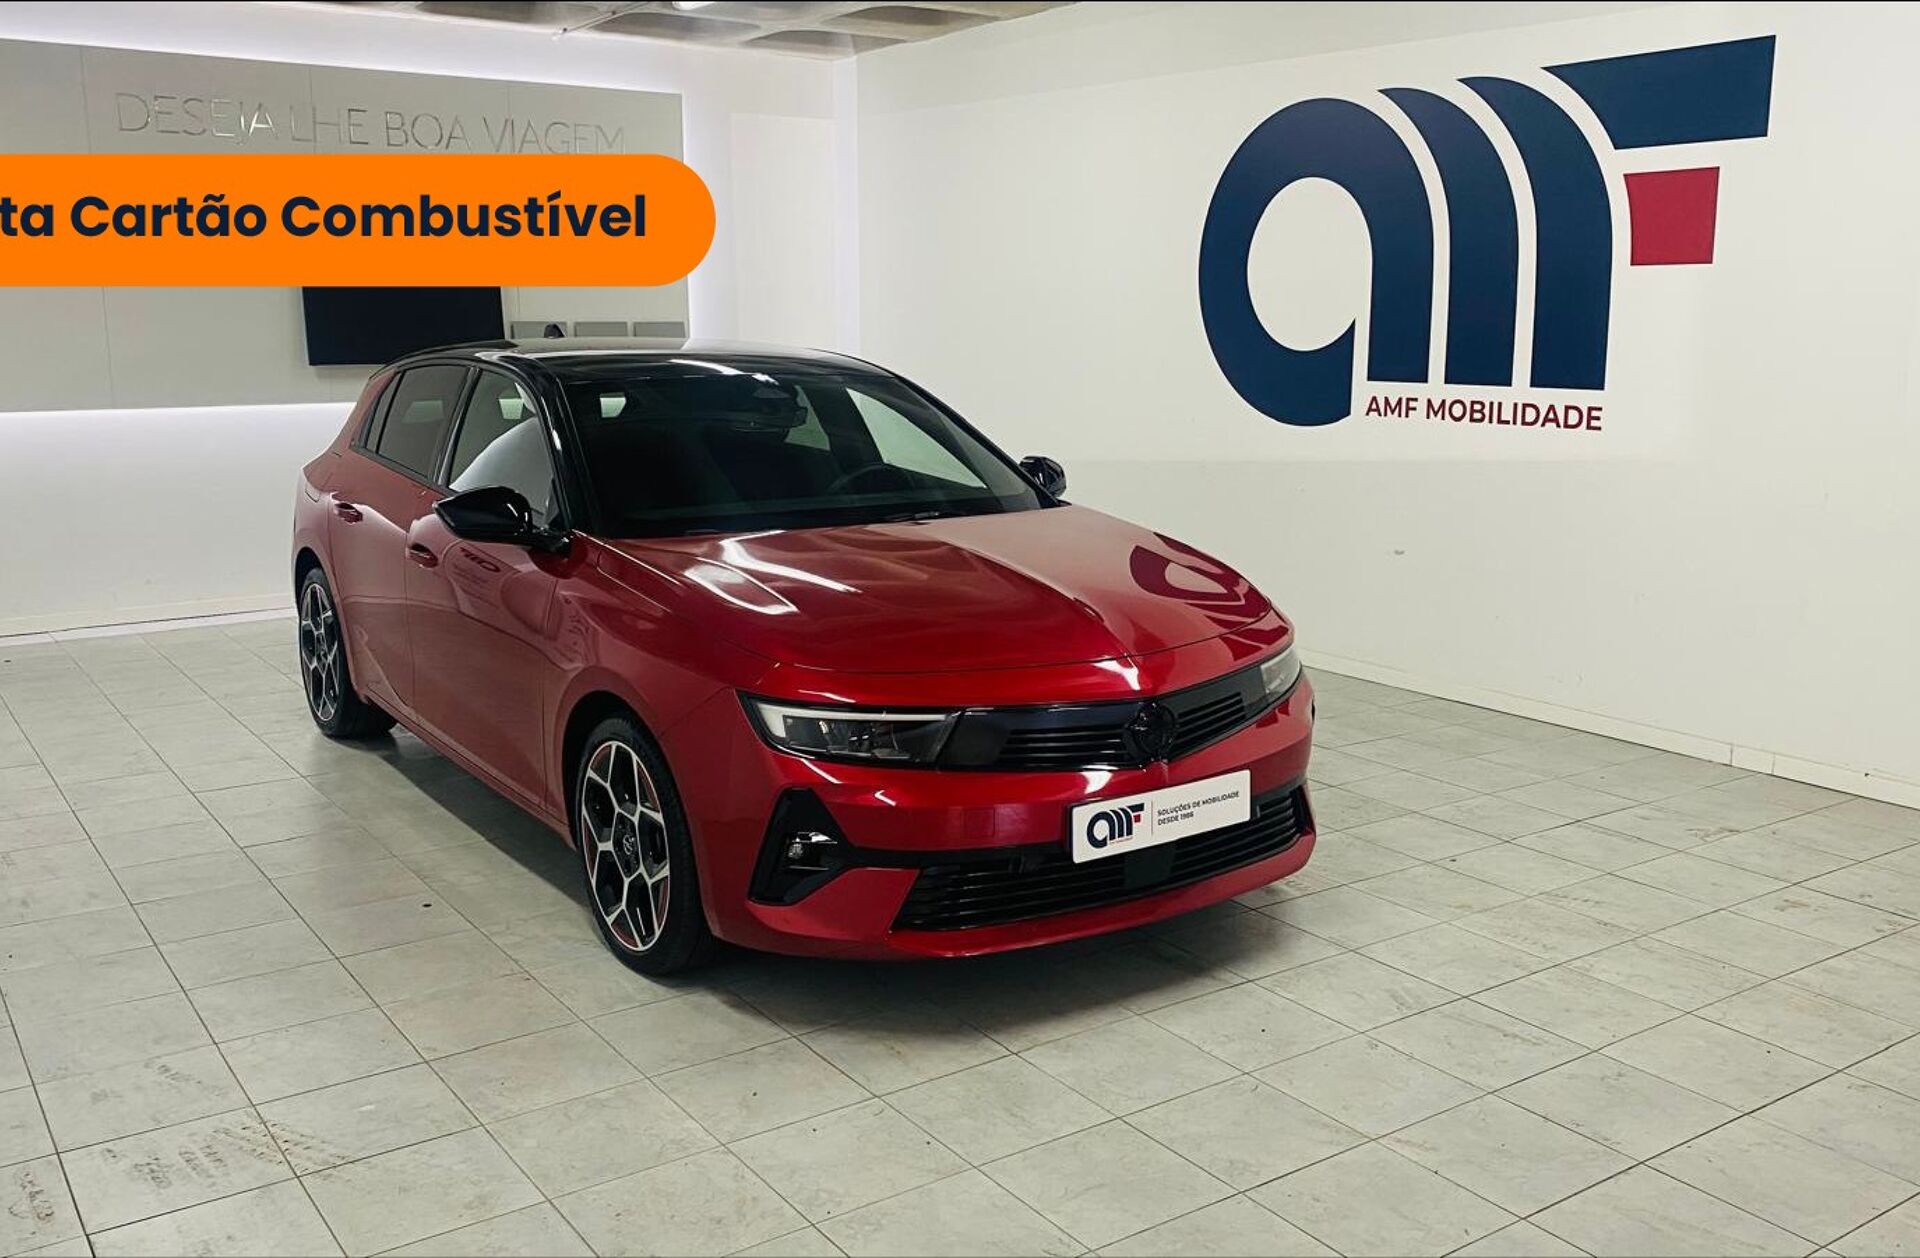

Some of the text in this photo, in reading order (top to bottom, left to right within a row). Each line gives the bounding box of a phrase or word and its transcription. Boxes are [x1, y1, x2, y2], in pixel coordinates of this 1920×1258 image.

[116, 92, 626, 155] DESEJA LHE BOA VIAGEM
[1365, 395, 1603, 431] AMF MOBILIDADE
[1192, 800, 1201, 808] DE
[1202, 790, 1240, 805] MOBILIDADE
[1157, 814, 1179, 826] DESDE
